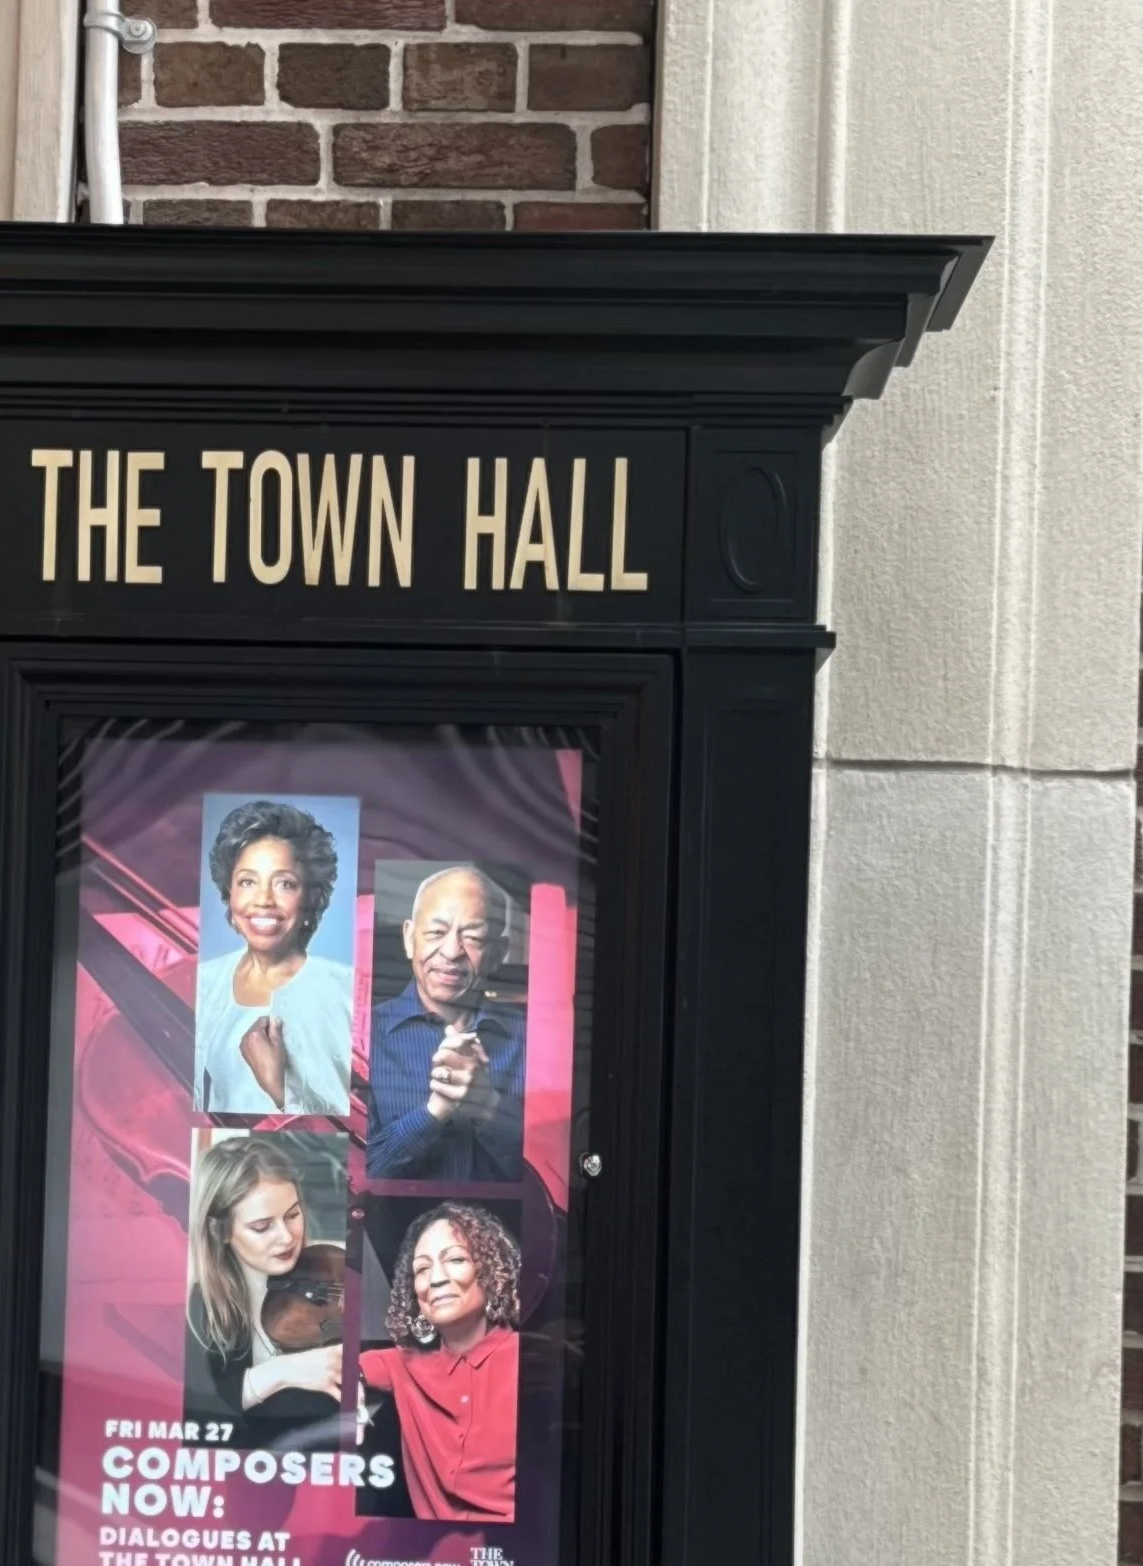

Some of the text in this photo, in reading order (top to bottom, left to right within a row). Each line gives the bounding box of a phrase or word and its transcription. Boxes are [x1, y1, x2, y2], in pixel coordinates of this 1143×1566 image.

[31, 449, 648, 592] THE TOWN HALL
[104, 1419, 234, 1442] FRI MAR 27
[101, 1446, 396, 1489] COMPOSERS
[101, 1482, 225, 1518] NOW:
[99, 1526, 291, 1552] DIALOGUES AT
[470, 1547, 504, 1560] THE
